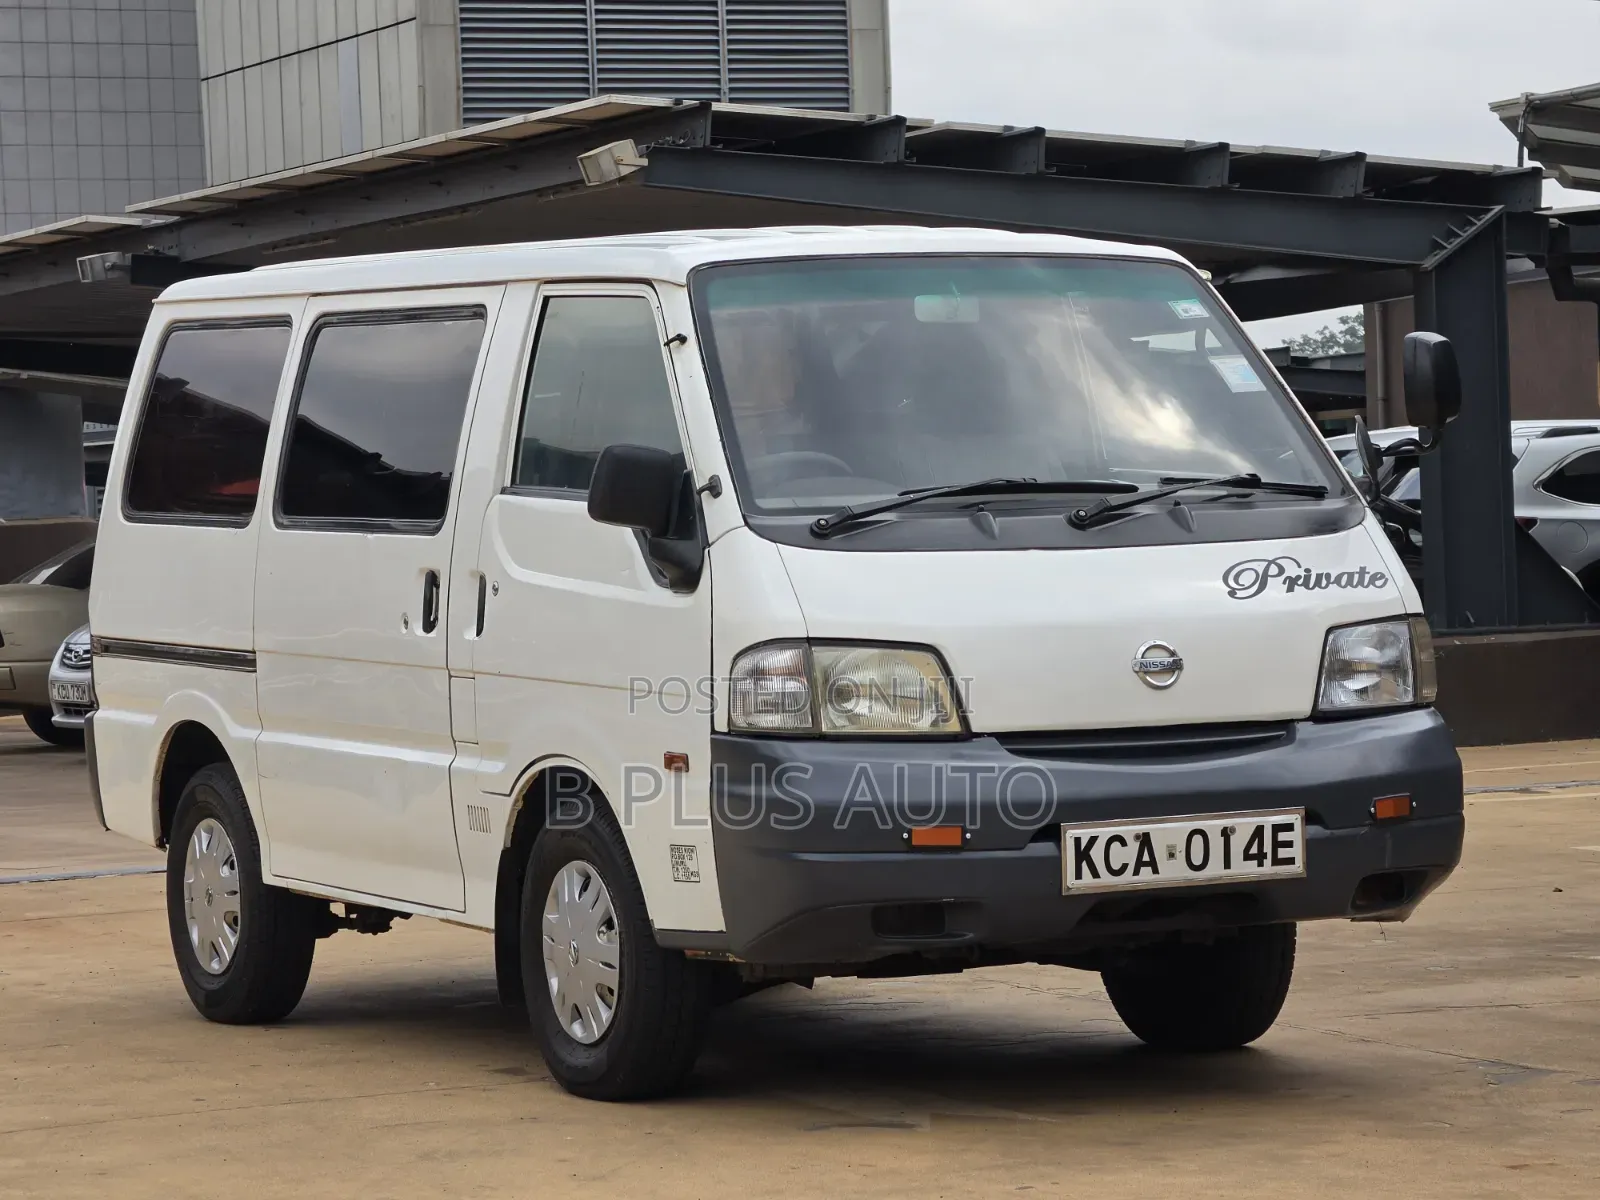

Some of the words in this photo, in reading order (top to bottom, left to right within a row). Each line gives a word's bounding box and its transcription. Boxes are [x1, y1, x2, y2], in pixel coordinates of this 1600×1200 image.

[1222, 556, 1389, 600] Private
[1073, 832, 1161, 880] KCA
[1184, 822, 1296, 872] 014E
